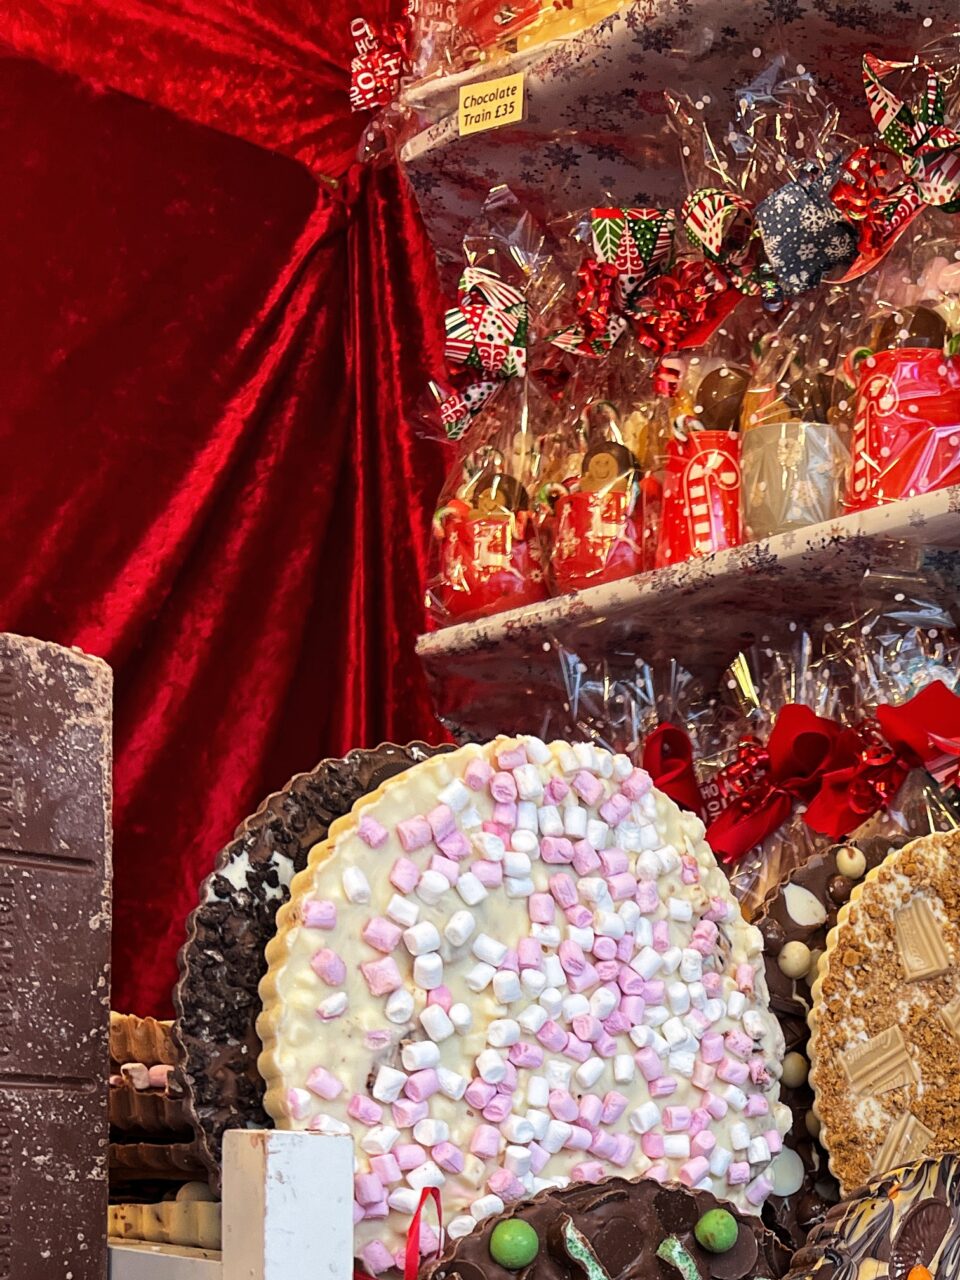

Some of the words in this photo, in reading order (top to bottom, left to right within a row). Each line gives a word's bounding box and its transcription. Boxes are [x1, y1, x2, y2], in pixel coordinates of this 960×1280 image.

[463, 84, 518, 110] Chocolate
[463, 109, 491, 127] Train
[495, 101, 515, 119] £35
